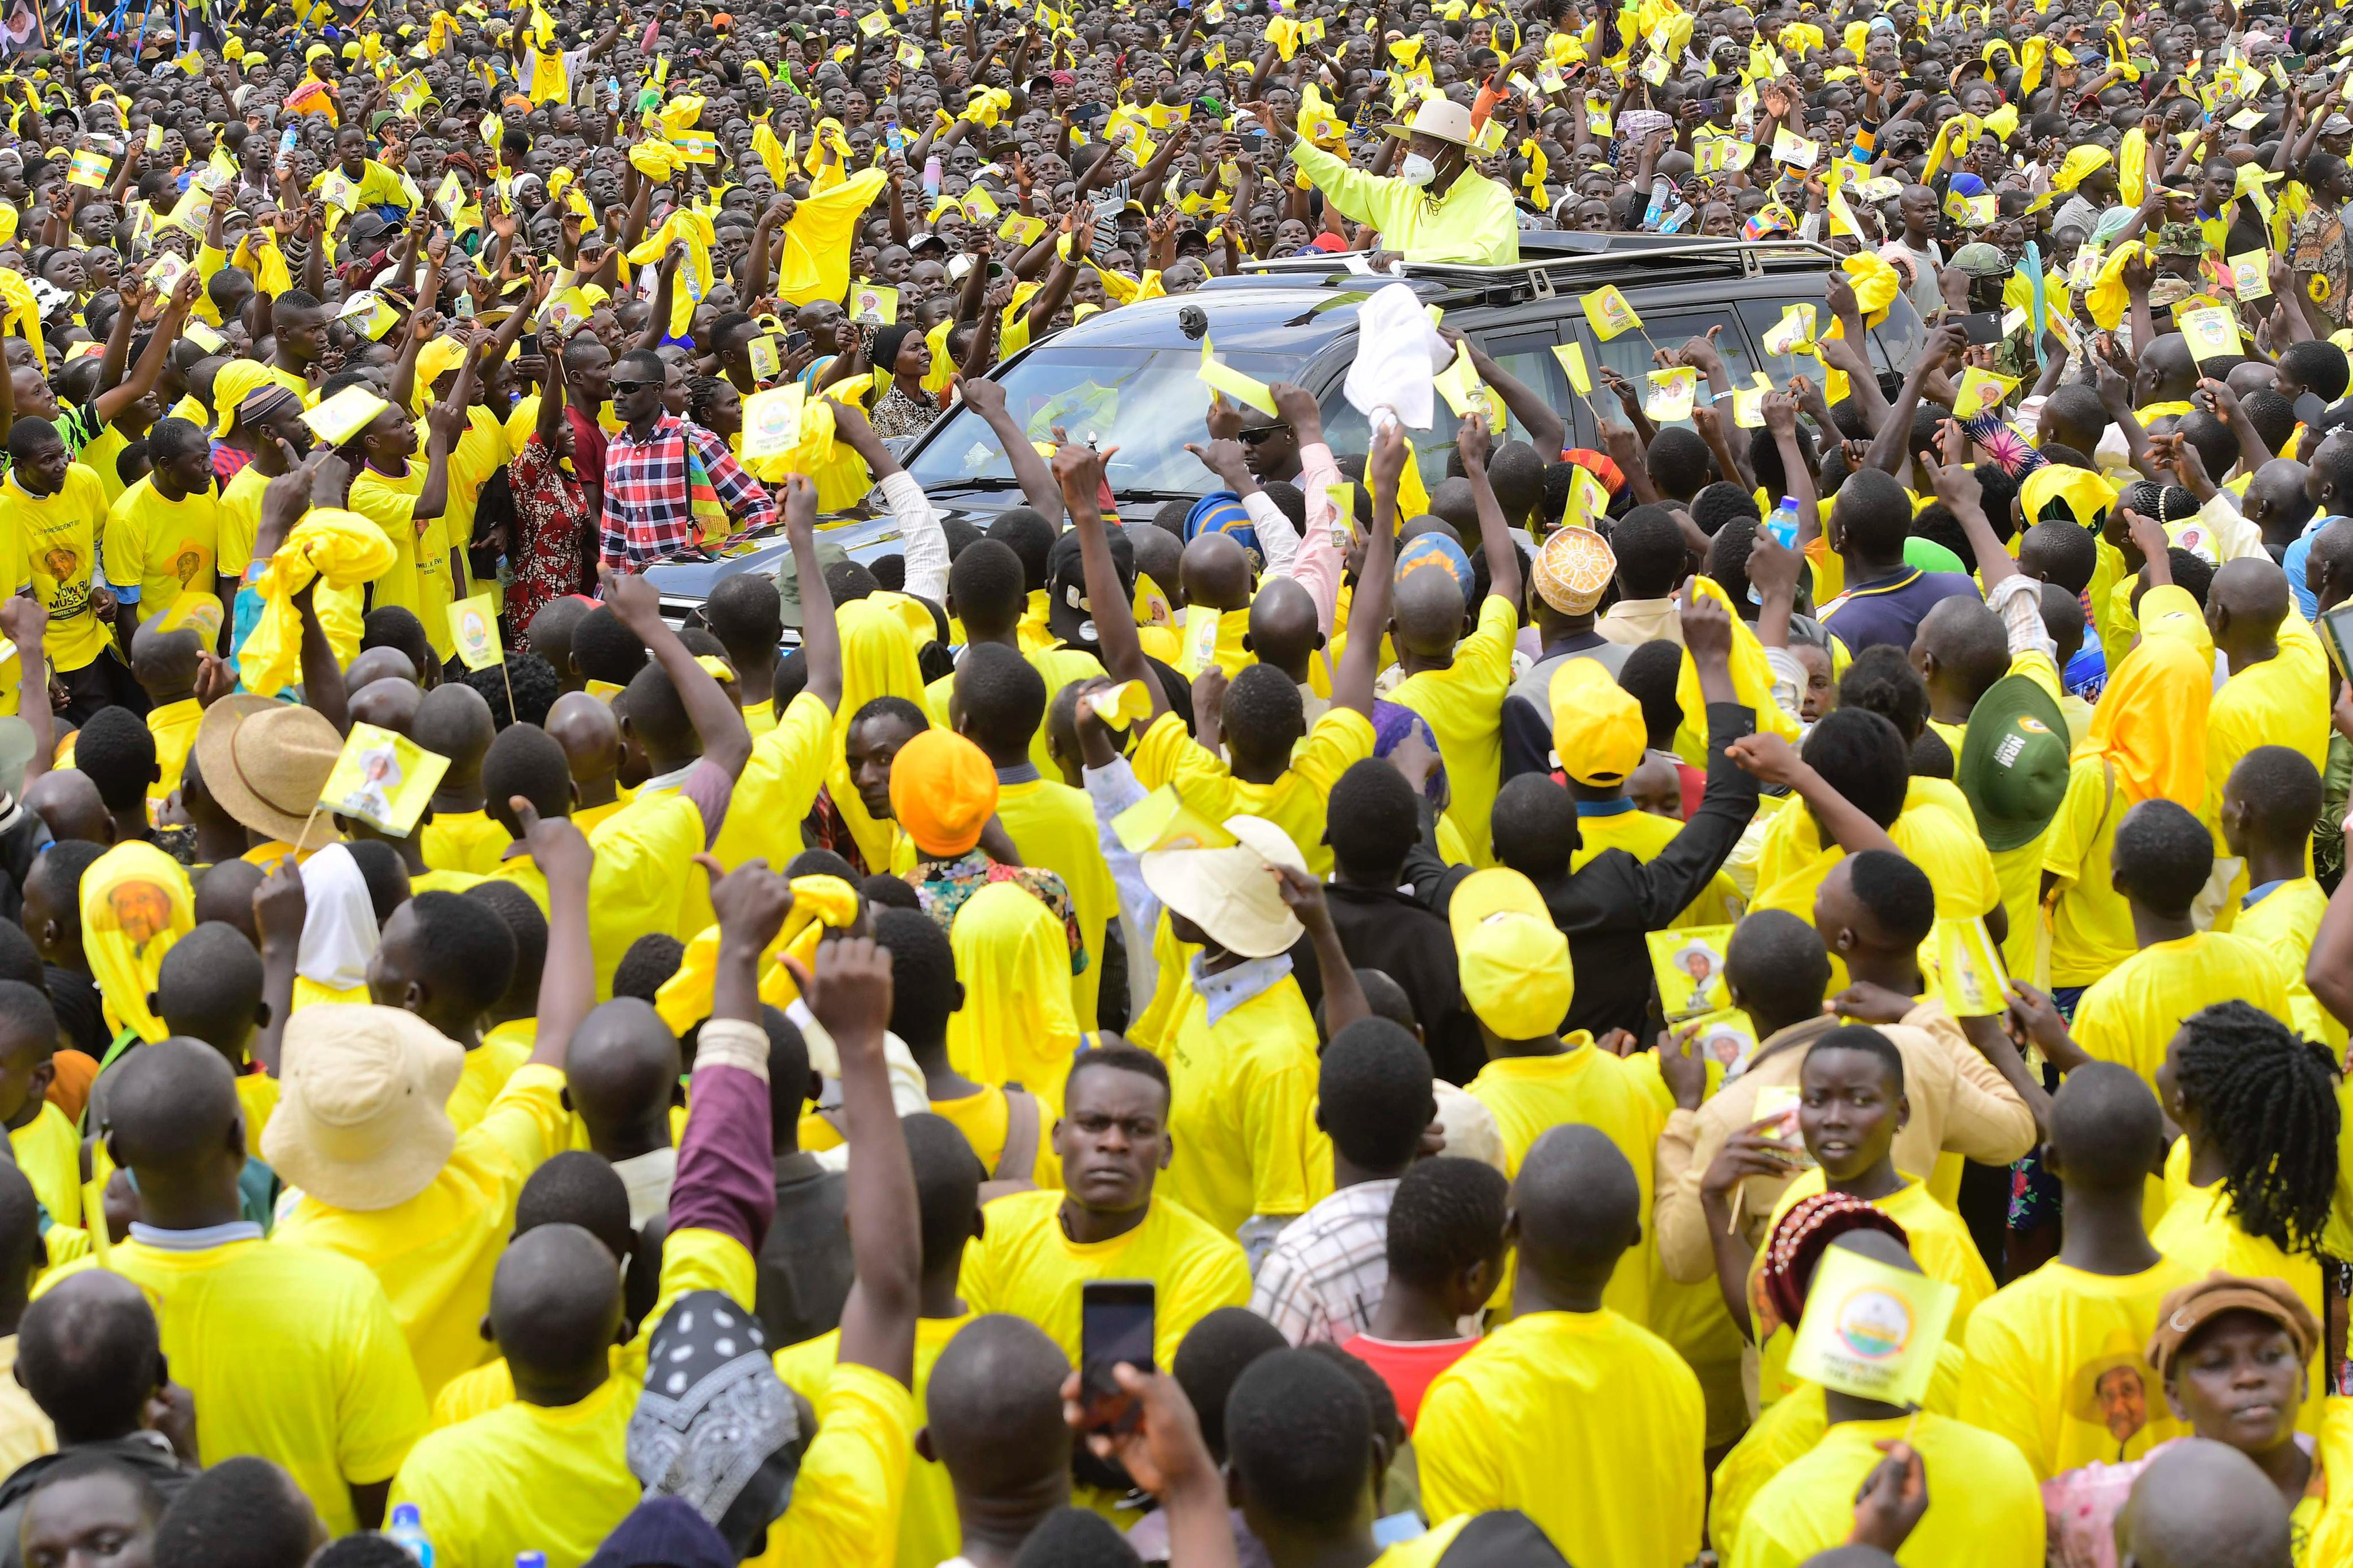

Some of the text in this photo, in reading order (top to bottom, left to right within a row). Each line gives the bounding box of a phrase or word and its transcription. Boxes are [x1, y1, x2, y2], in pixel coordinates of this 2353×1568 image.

[1610, 316, 1630, 327] PROTEC
[1987, 373, 2012, 384] PRESIDENT
[44, 521, 74, 534] PRESIDENT
[1998, 735, 2026, 768] NRM
